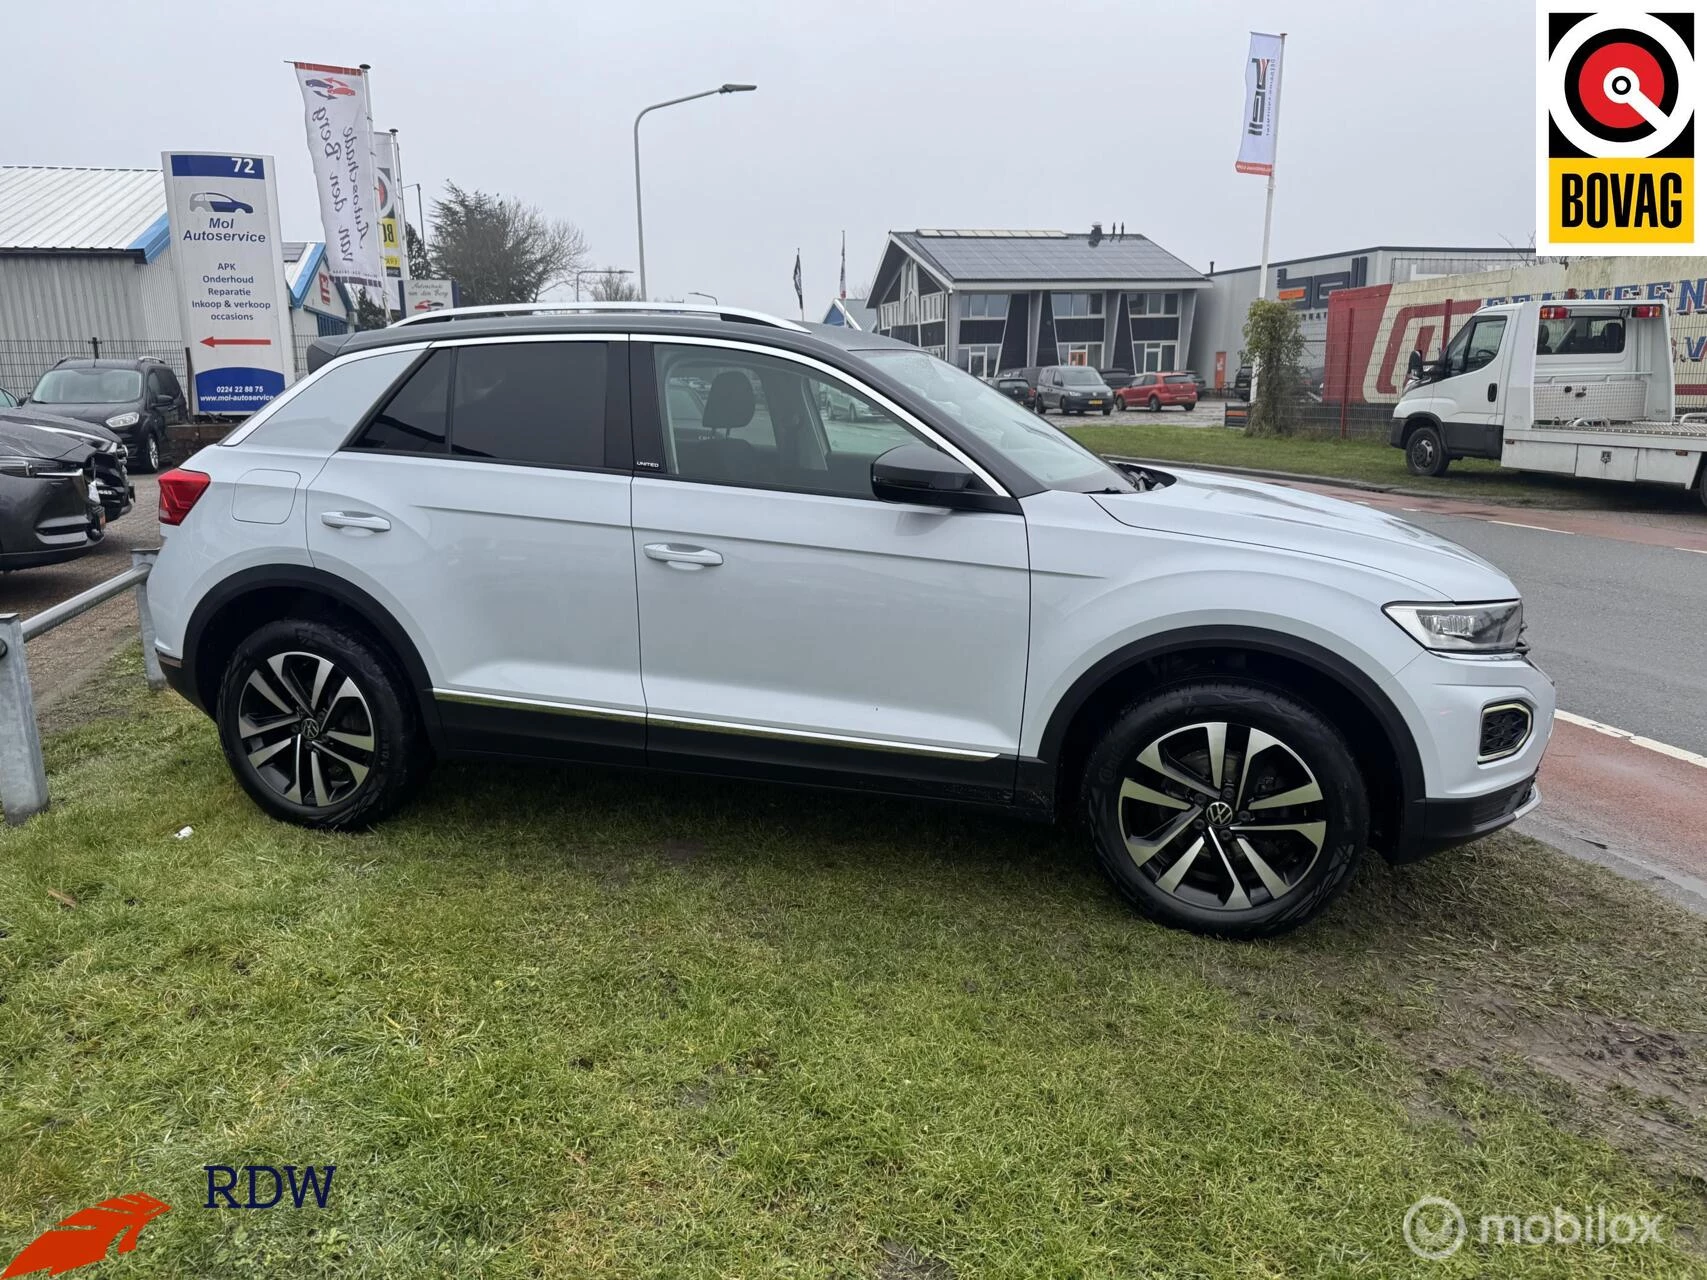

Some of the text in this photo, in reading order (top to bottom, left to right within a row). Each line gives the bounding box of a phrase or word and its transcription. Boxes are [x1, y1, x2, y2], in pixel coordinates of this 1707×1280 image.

[231, 157, 255, 174] 72
[209, 217, 234, 229] Mol
[183, 230, 266, 243] Autoservice
[217, 262, 236, 271] APK
[202, 275, 254, 284] Onderhoud
[208, 287, 251, 297] Reparatie
[191, 299, 271, 310] Inkoop & verkoop
[210, 312, 254, 321] occasions
